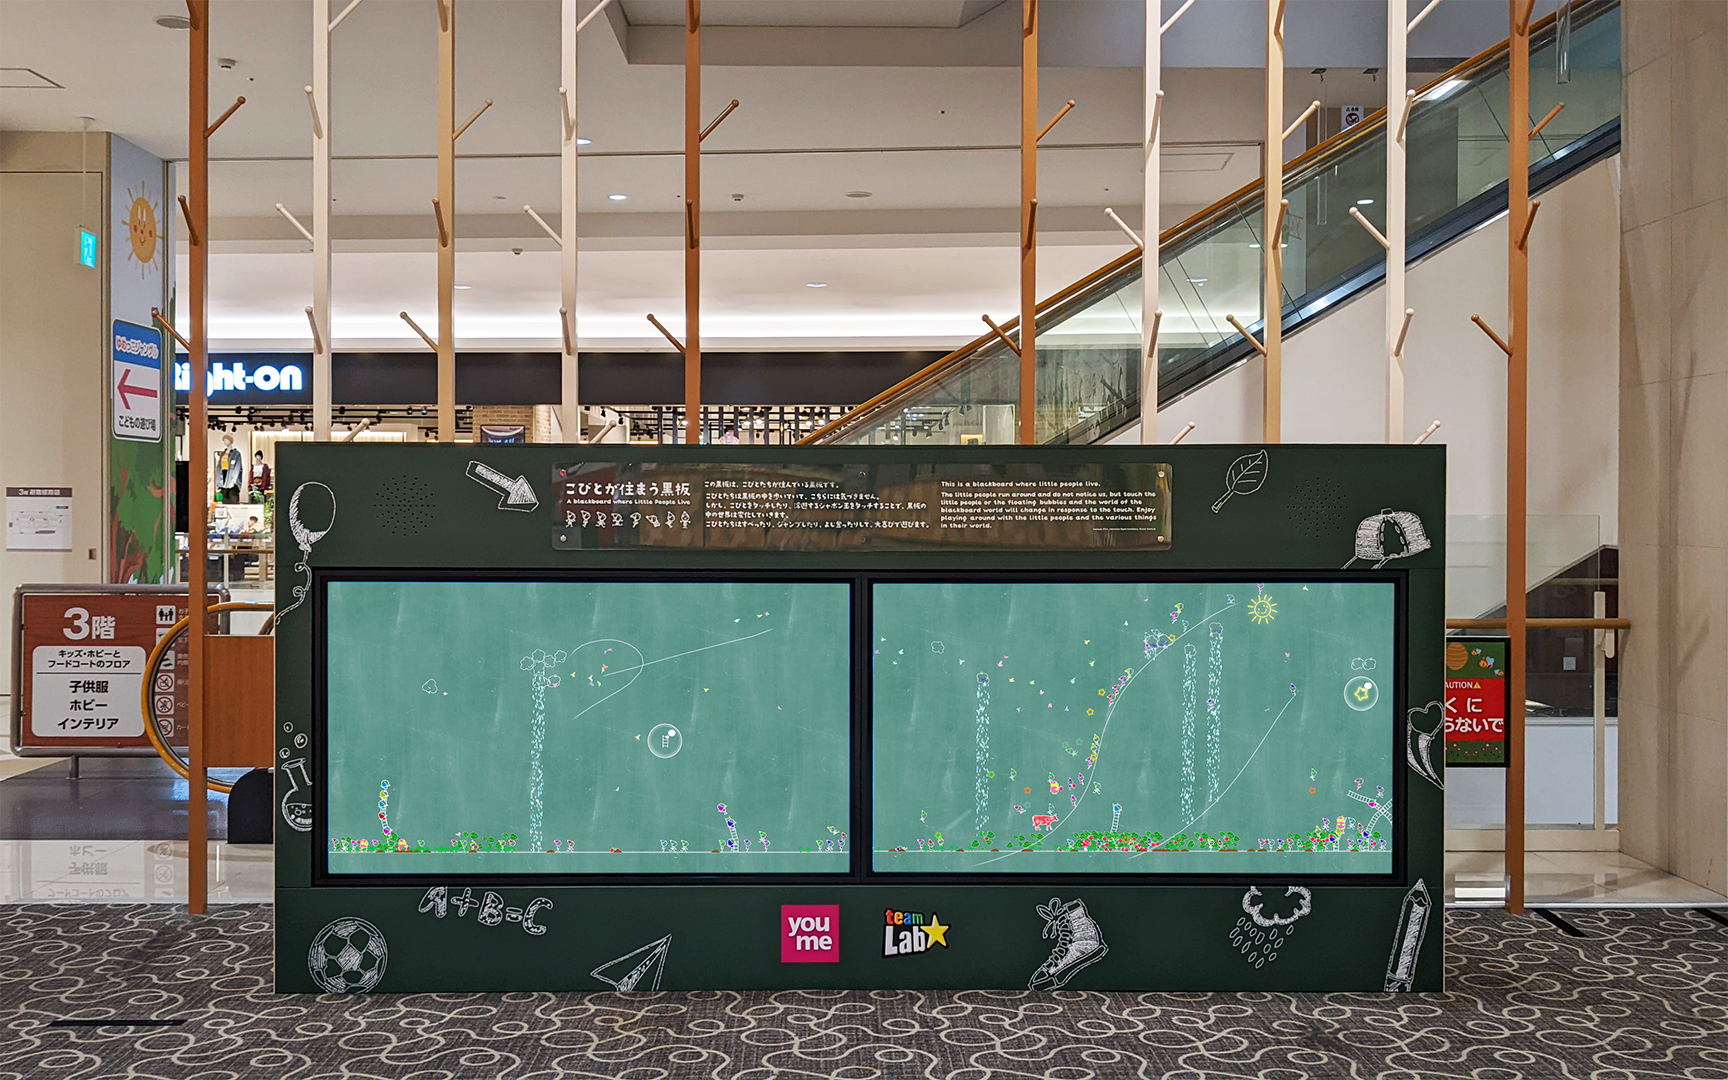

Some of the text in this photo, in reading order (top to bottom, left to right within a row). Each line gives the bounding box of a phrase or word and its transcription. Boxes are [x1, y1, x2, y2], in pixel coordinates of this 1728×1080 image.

[174, 362, 303, 397] iht-on
[566, 481, 691, 497] こびとが住まう黒板
[974, 491, 997, 499] people
[613, 497, 633, 505] where
[654, 498, 676, 506] People
[960, 499, 982, 507] people
[1007, 498, 1037, 507] floating
[941, 506, 981, 514] blackboard
[1020, 507, 1046, 515] change
[1136, 506, 1155, 514] Enjoy
[941, 514, 967, 523] playing
[1050, 514, 1074, 522] people
[1134, 514, 1157, 522] things
[62, 607, 116, 640] 3階
[58, 649, 121, 659] キッズ・ホビーと
[48, 660, 131, 669] フードコートのフロア
[69, 680, 109, 694] 子供服
[69, 699, 108, 712] ホビー
[1445, 697, 1482, 713] くに
[57, 718, 119, 730] インテリア
[1445, 717, 1504, 733] らないで
[885, 909, 924, 925] team
[788, 917, 830, 937] you
[796, 935, 833, 950] me
[884, 925, 926, 956] Lab
